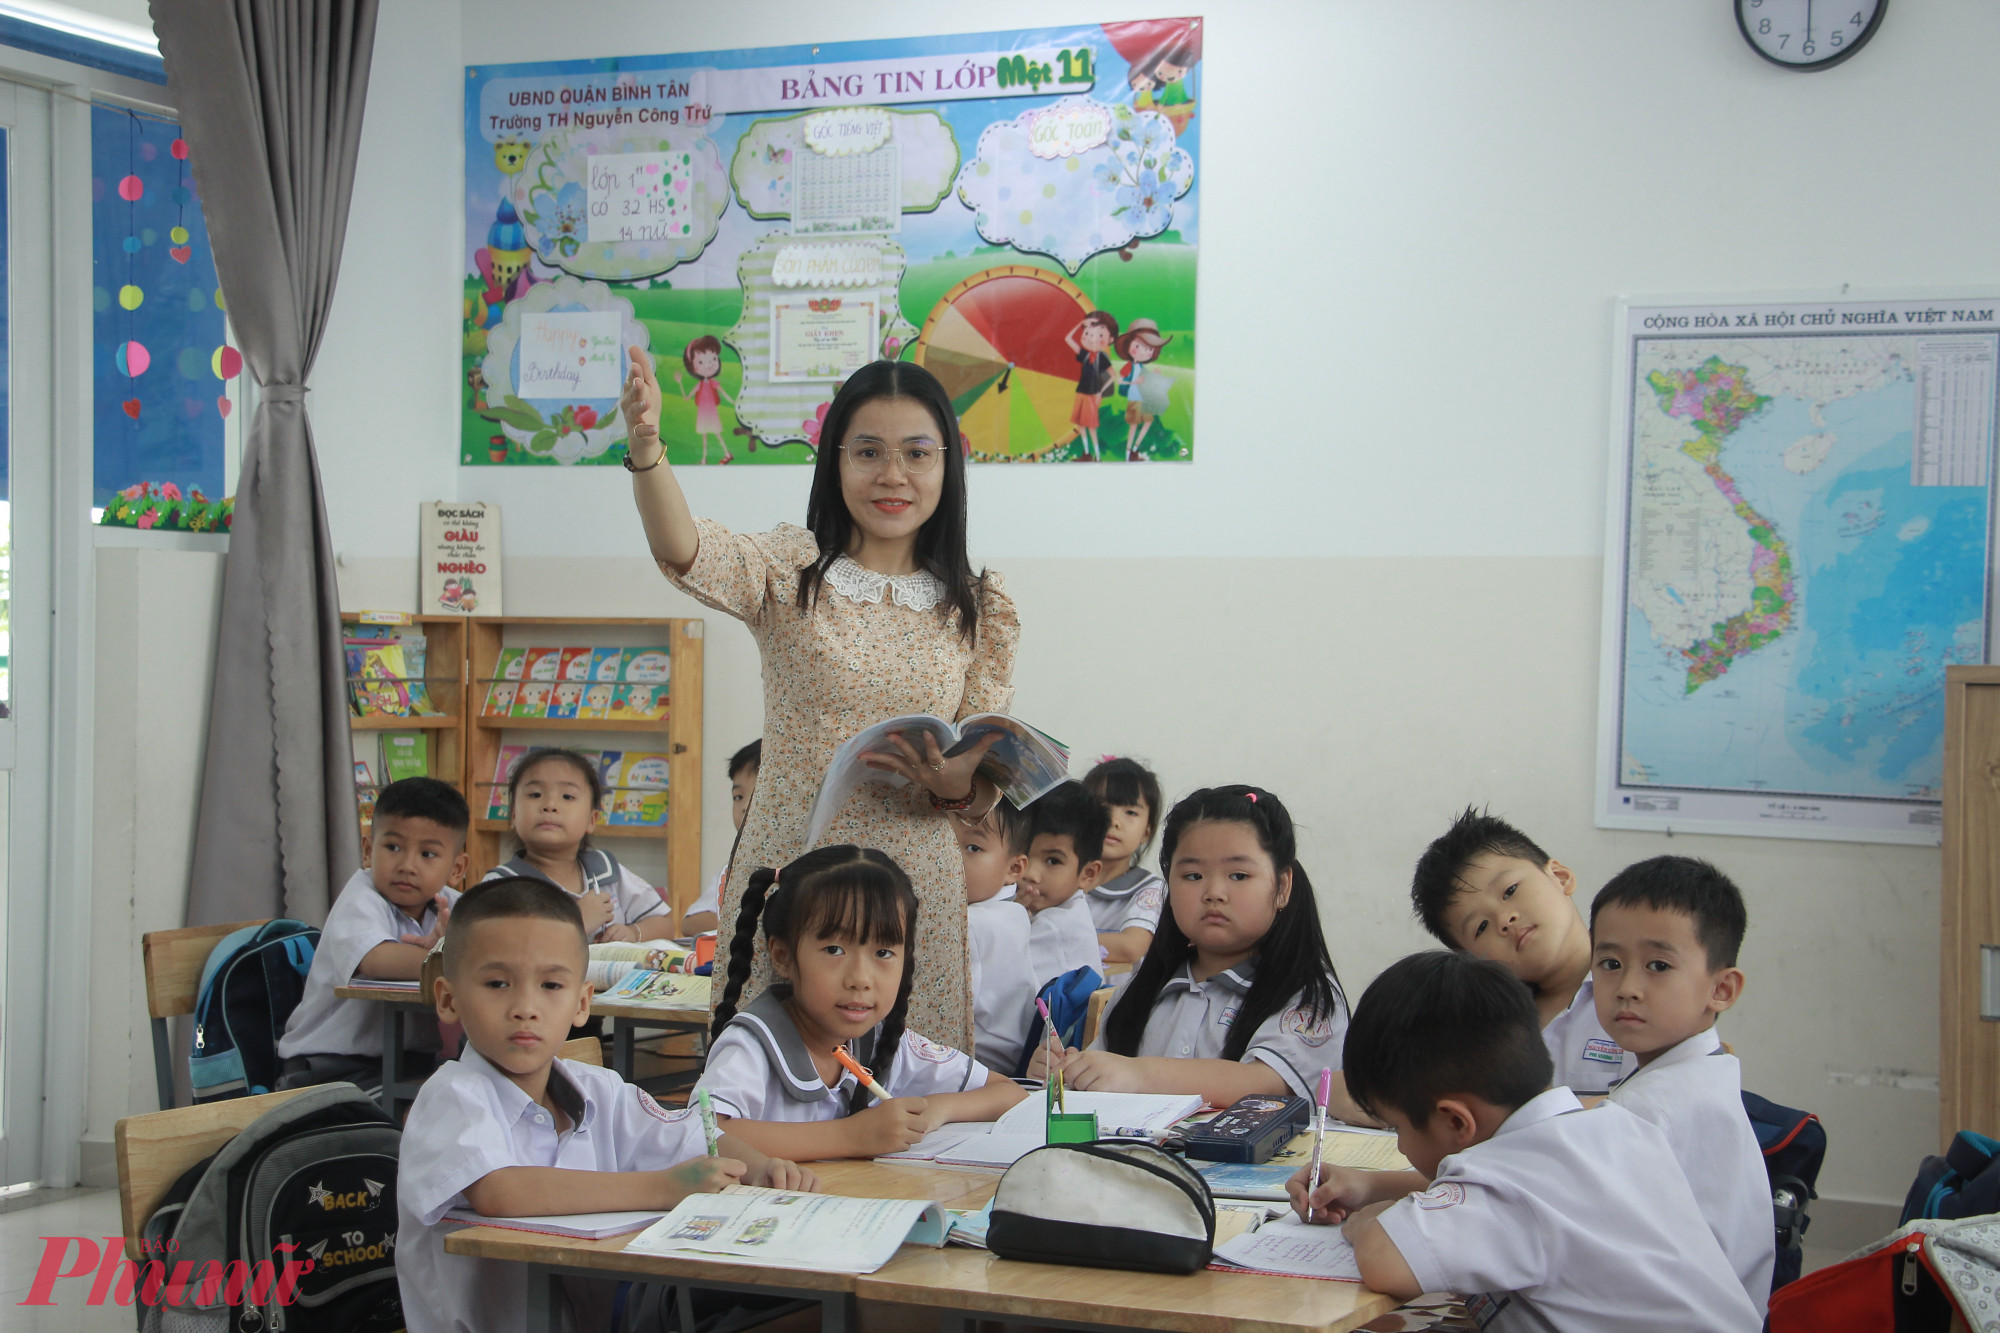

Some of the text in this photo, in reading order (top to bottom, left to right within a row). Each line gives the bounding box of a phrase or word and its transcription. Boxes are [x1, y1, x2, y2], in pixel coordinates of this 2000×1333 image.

[1759, 18, 1771, 34] 8
[1850, 11, 1863, 27] 4
[1778, 34, 1790, 49] 7
[1803, 39, 1815, 56] 6
[1831, 31, 1843, 47] 5
[781, 48, 1095, 100] BẢNG TIN LỚP Một 11
[509, 80, 689, 106] UBND QUẬN BÌNH TÂN
[490, 104, 712, 131] Trường TH Nguyễn Công Trứ
[814, 120, 833, 139] GÓC
[623, 200, 640, 216] 32
[650, 199, 665, 214] HS
[619, 227, 632, 240] 14
[1644, 308, 1994, 331] CỘNG HÒA XÃ HỘI CHỦ NGHĨA VIỆT NAM
[524, 360, 581, 391] Birthday
[438, 509, 484, 518] ĐỌC SÁCH
[444, 528, 478, 542] GIÀU
[438, 560, 487, 574] NGHÈO
[323, 1191, 368, 1210] BACK
[342, 1231, 364, 1247] TO
[323, 1242, 385, 1267] SCHOOL
